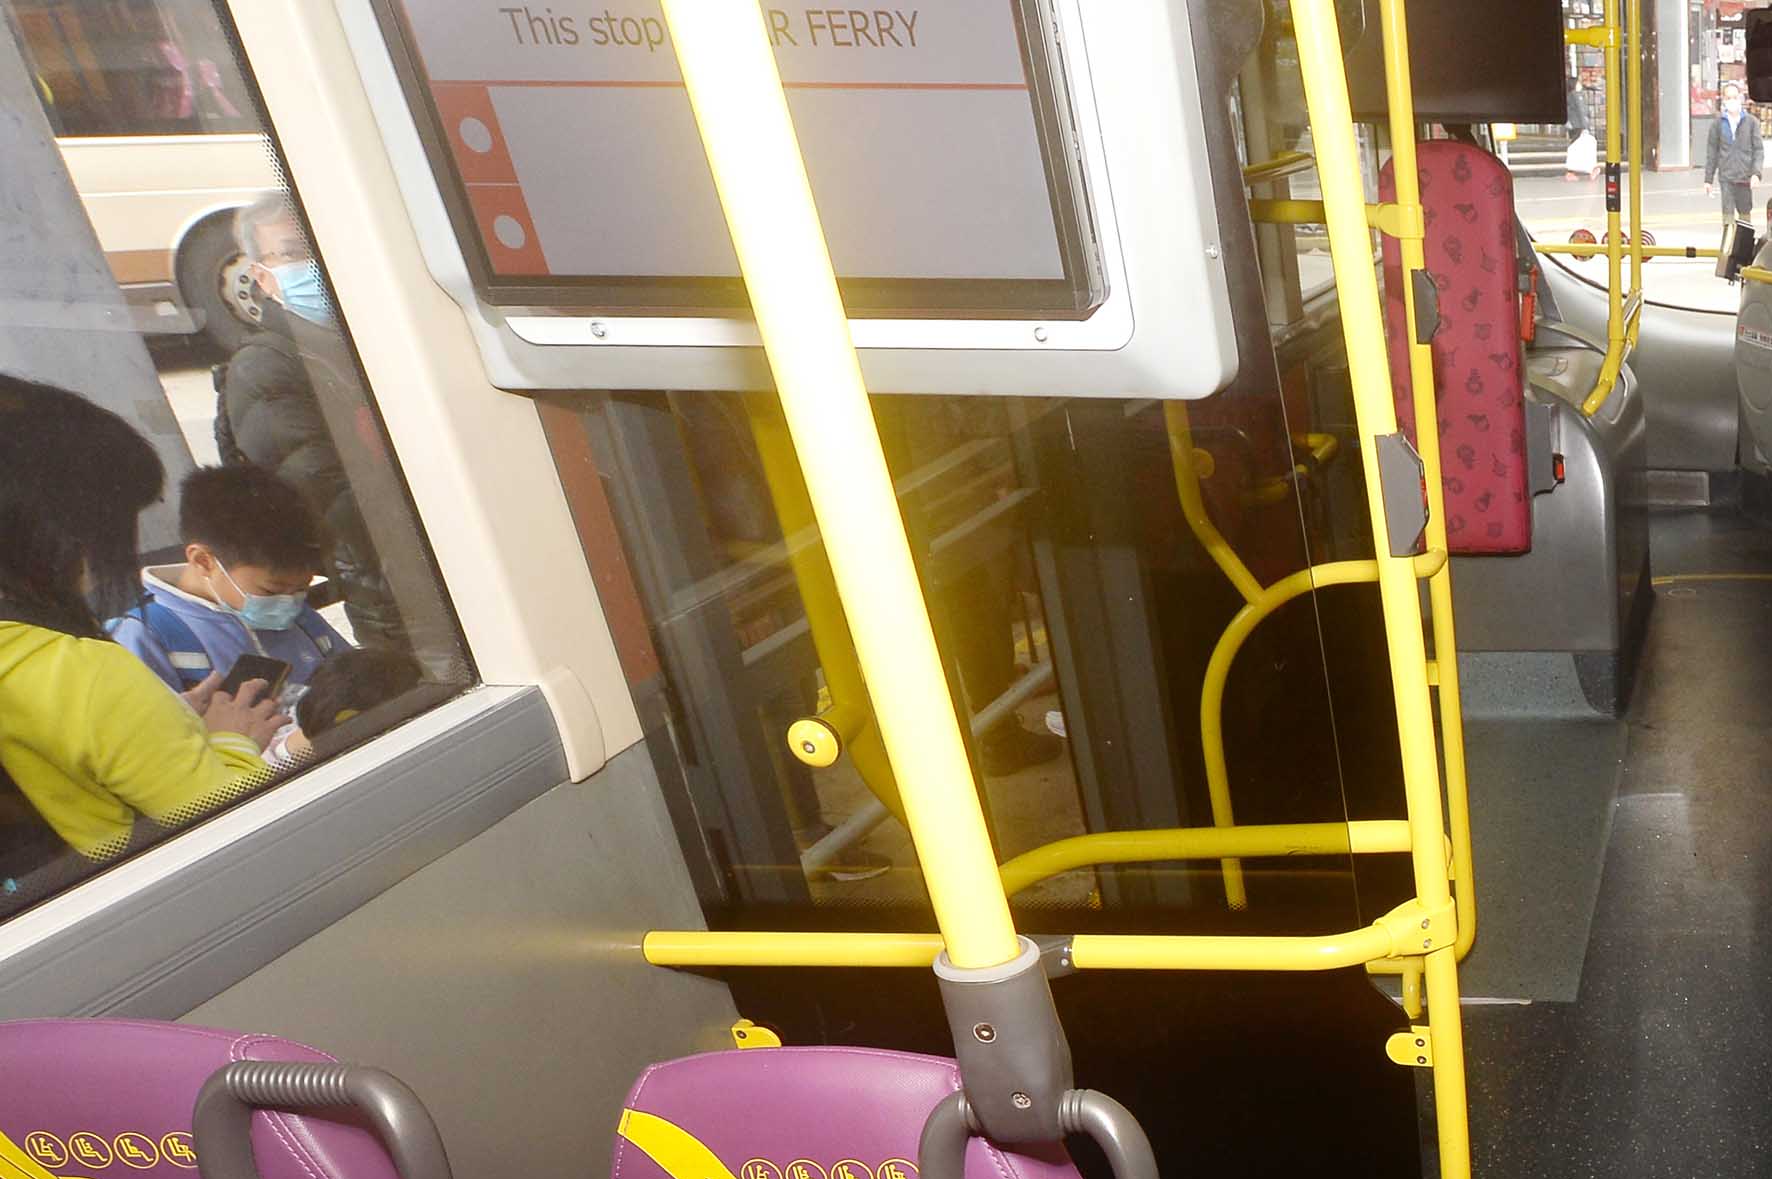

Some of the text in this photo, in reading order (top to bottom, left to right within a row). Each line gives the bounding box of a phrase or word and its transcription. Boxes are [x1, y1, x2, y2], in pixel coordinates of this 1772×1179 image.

[500, 7, 579, 46] This
[588, 10, 665, 52] stop
[805, 10, 918, 48] FERRY
